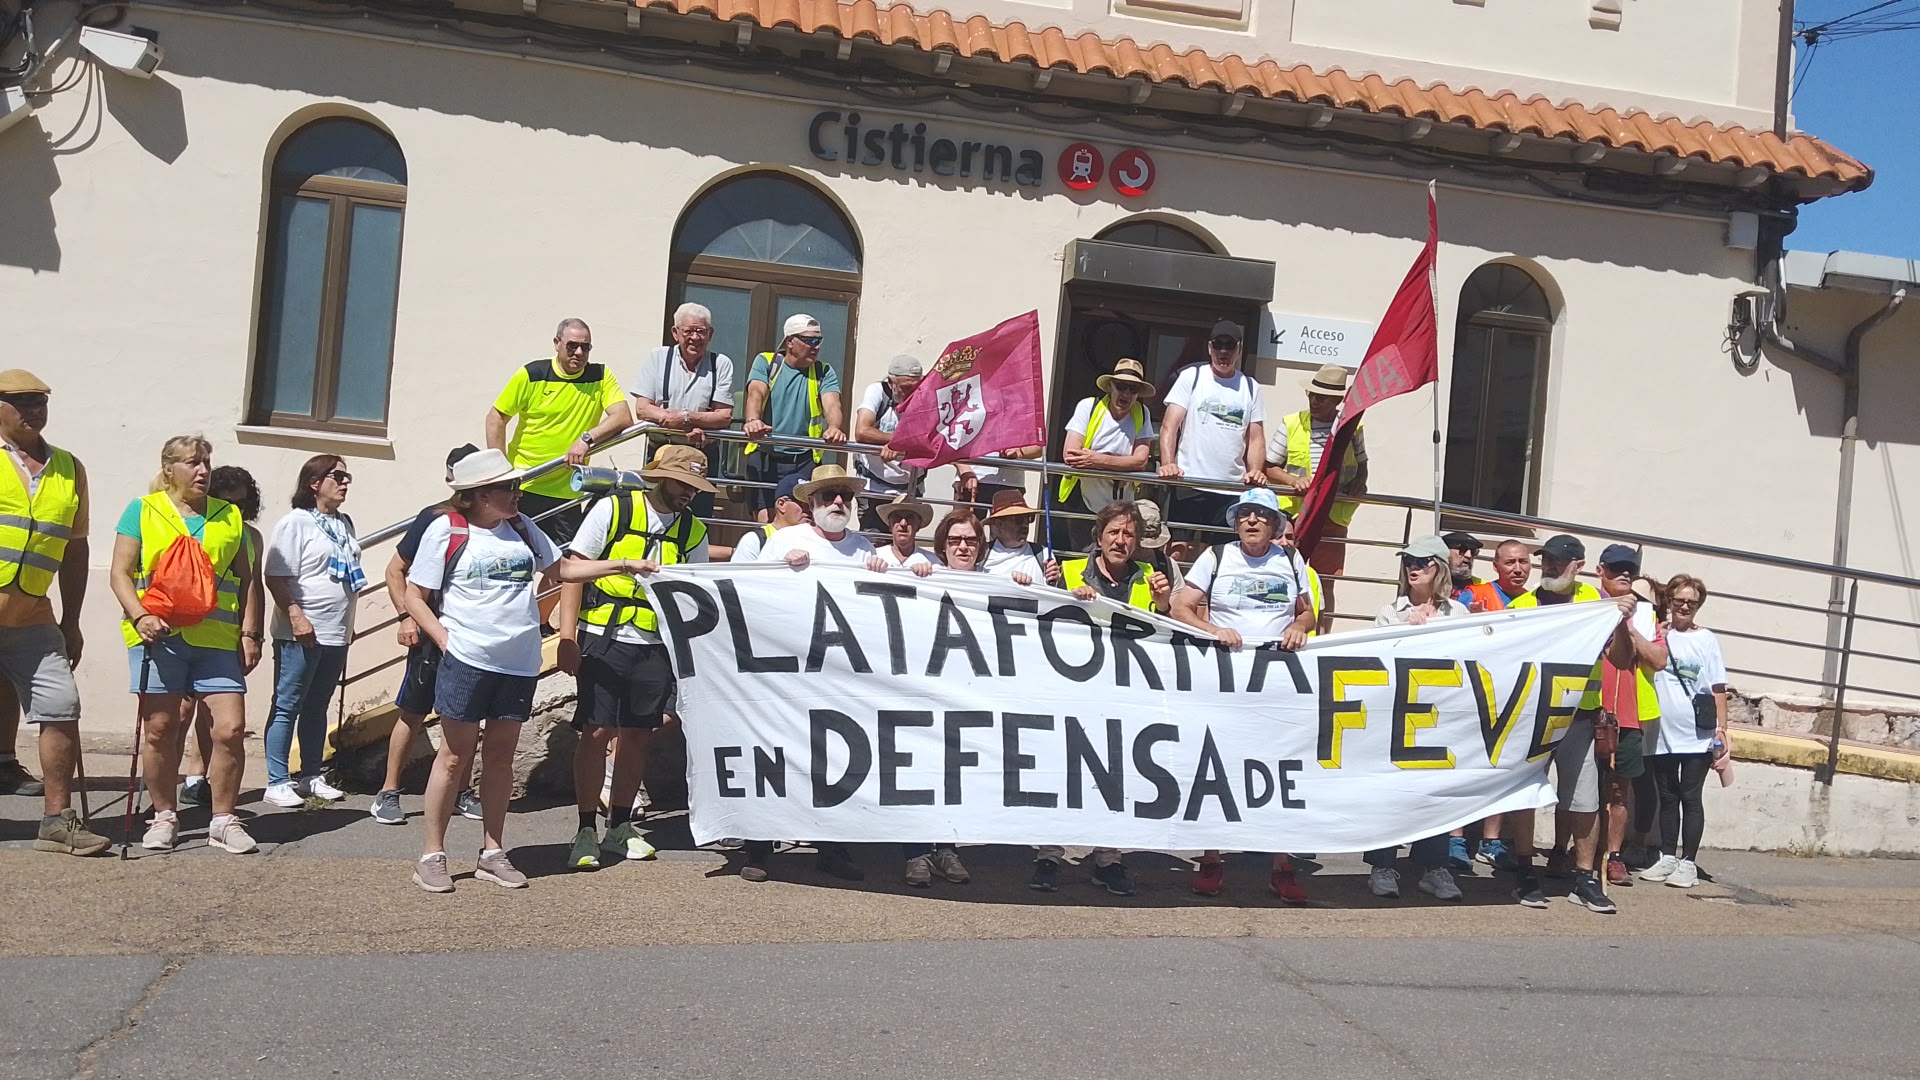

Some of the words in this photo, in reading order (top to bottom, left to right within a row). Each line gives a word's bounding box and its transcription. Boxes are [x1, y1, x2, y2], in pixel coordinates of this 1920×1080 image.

[808, 110, 1045, 187] Cistierna
[1299, 340, 1340, 357] Access
[1300, 325, 1345, 342] Acceso
[651, 579, 1314, 693] PLATAFORMA
[713, 745, 787, 798] EN
[808, 708, 1242, 823] DEFENSA
[1245, 758, 1306, 809] DE
[1317, 657, 1594, 769] FEVE
